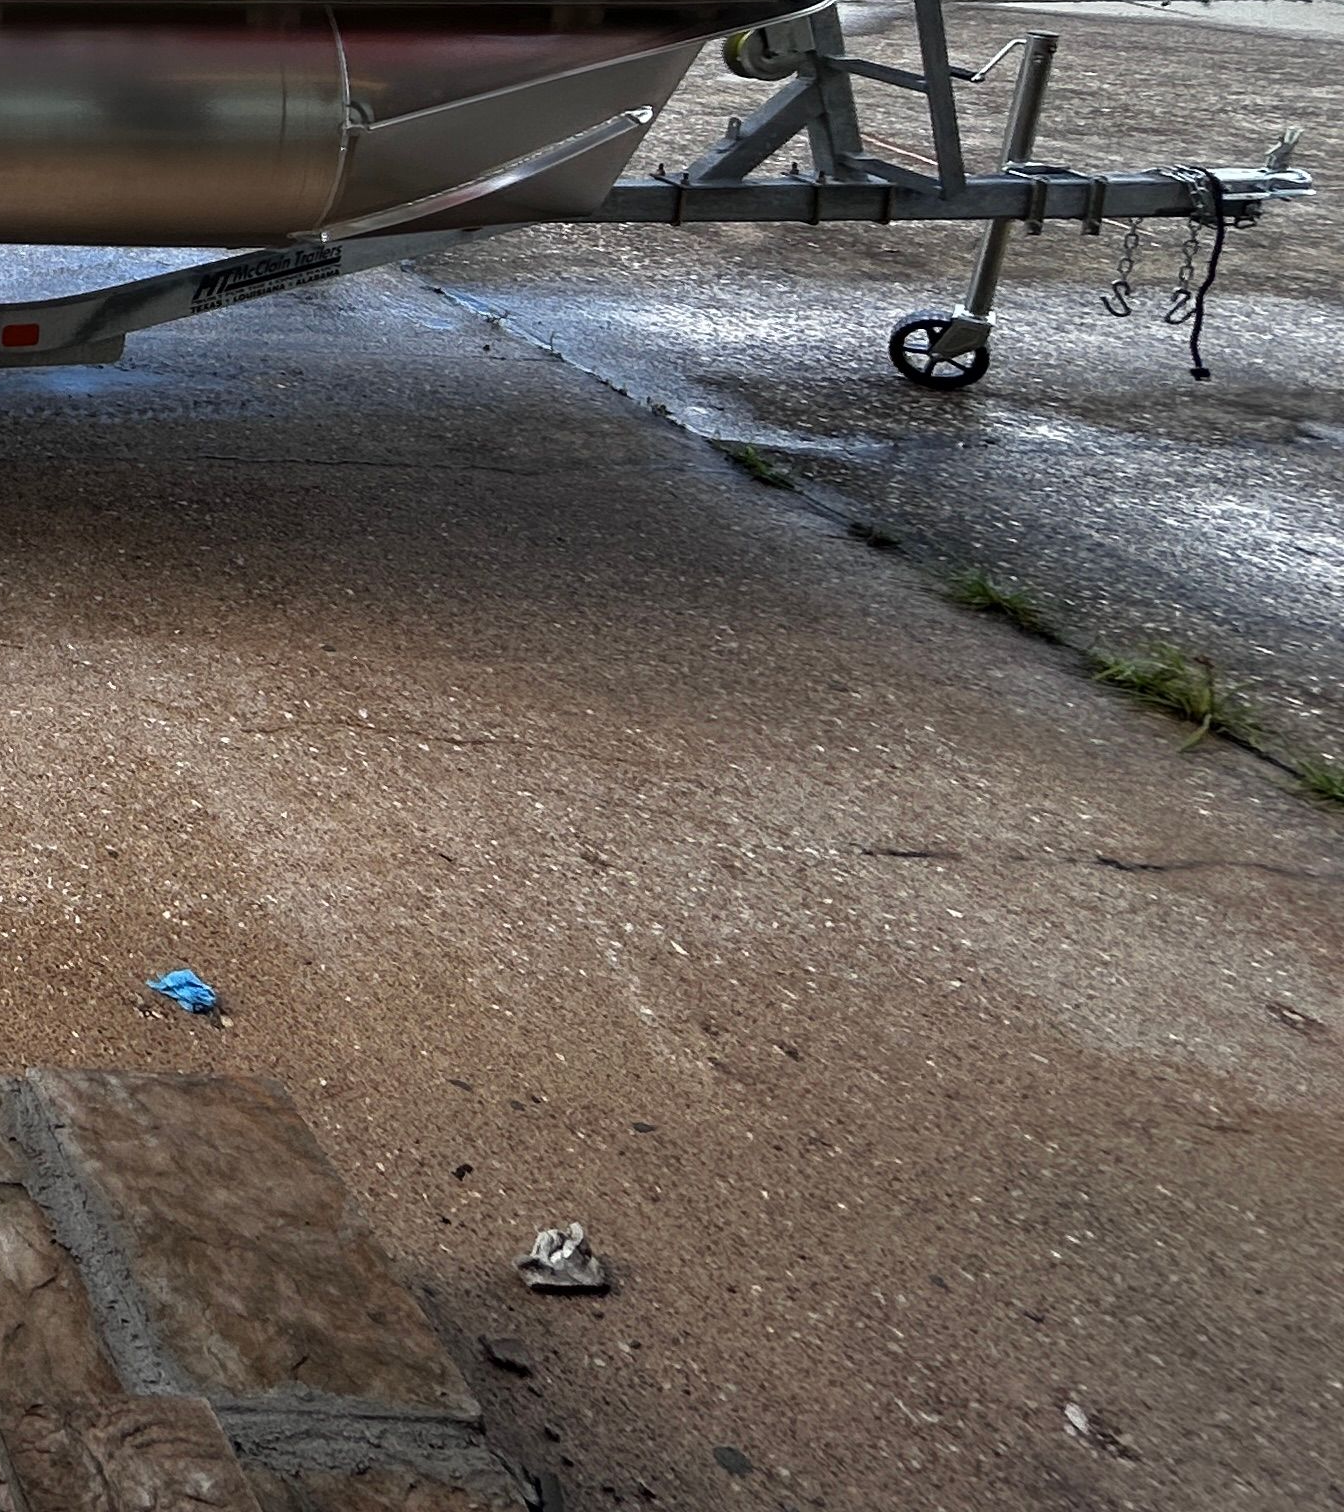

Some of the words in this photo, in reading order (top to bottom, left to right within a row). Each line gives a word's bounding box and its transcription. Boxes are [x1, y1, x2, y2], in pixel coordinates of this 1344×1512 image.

[294, 244, 343, 266] Trailers
[233, 283, 286, 303] LOUISIANA
[295, 268, 341, 285] ALABAMA
